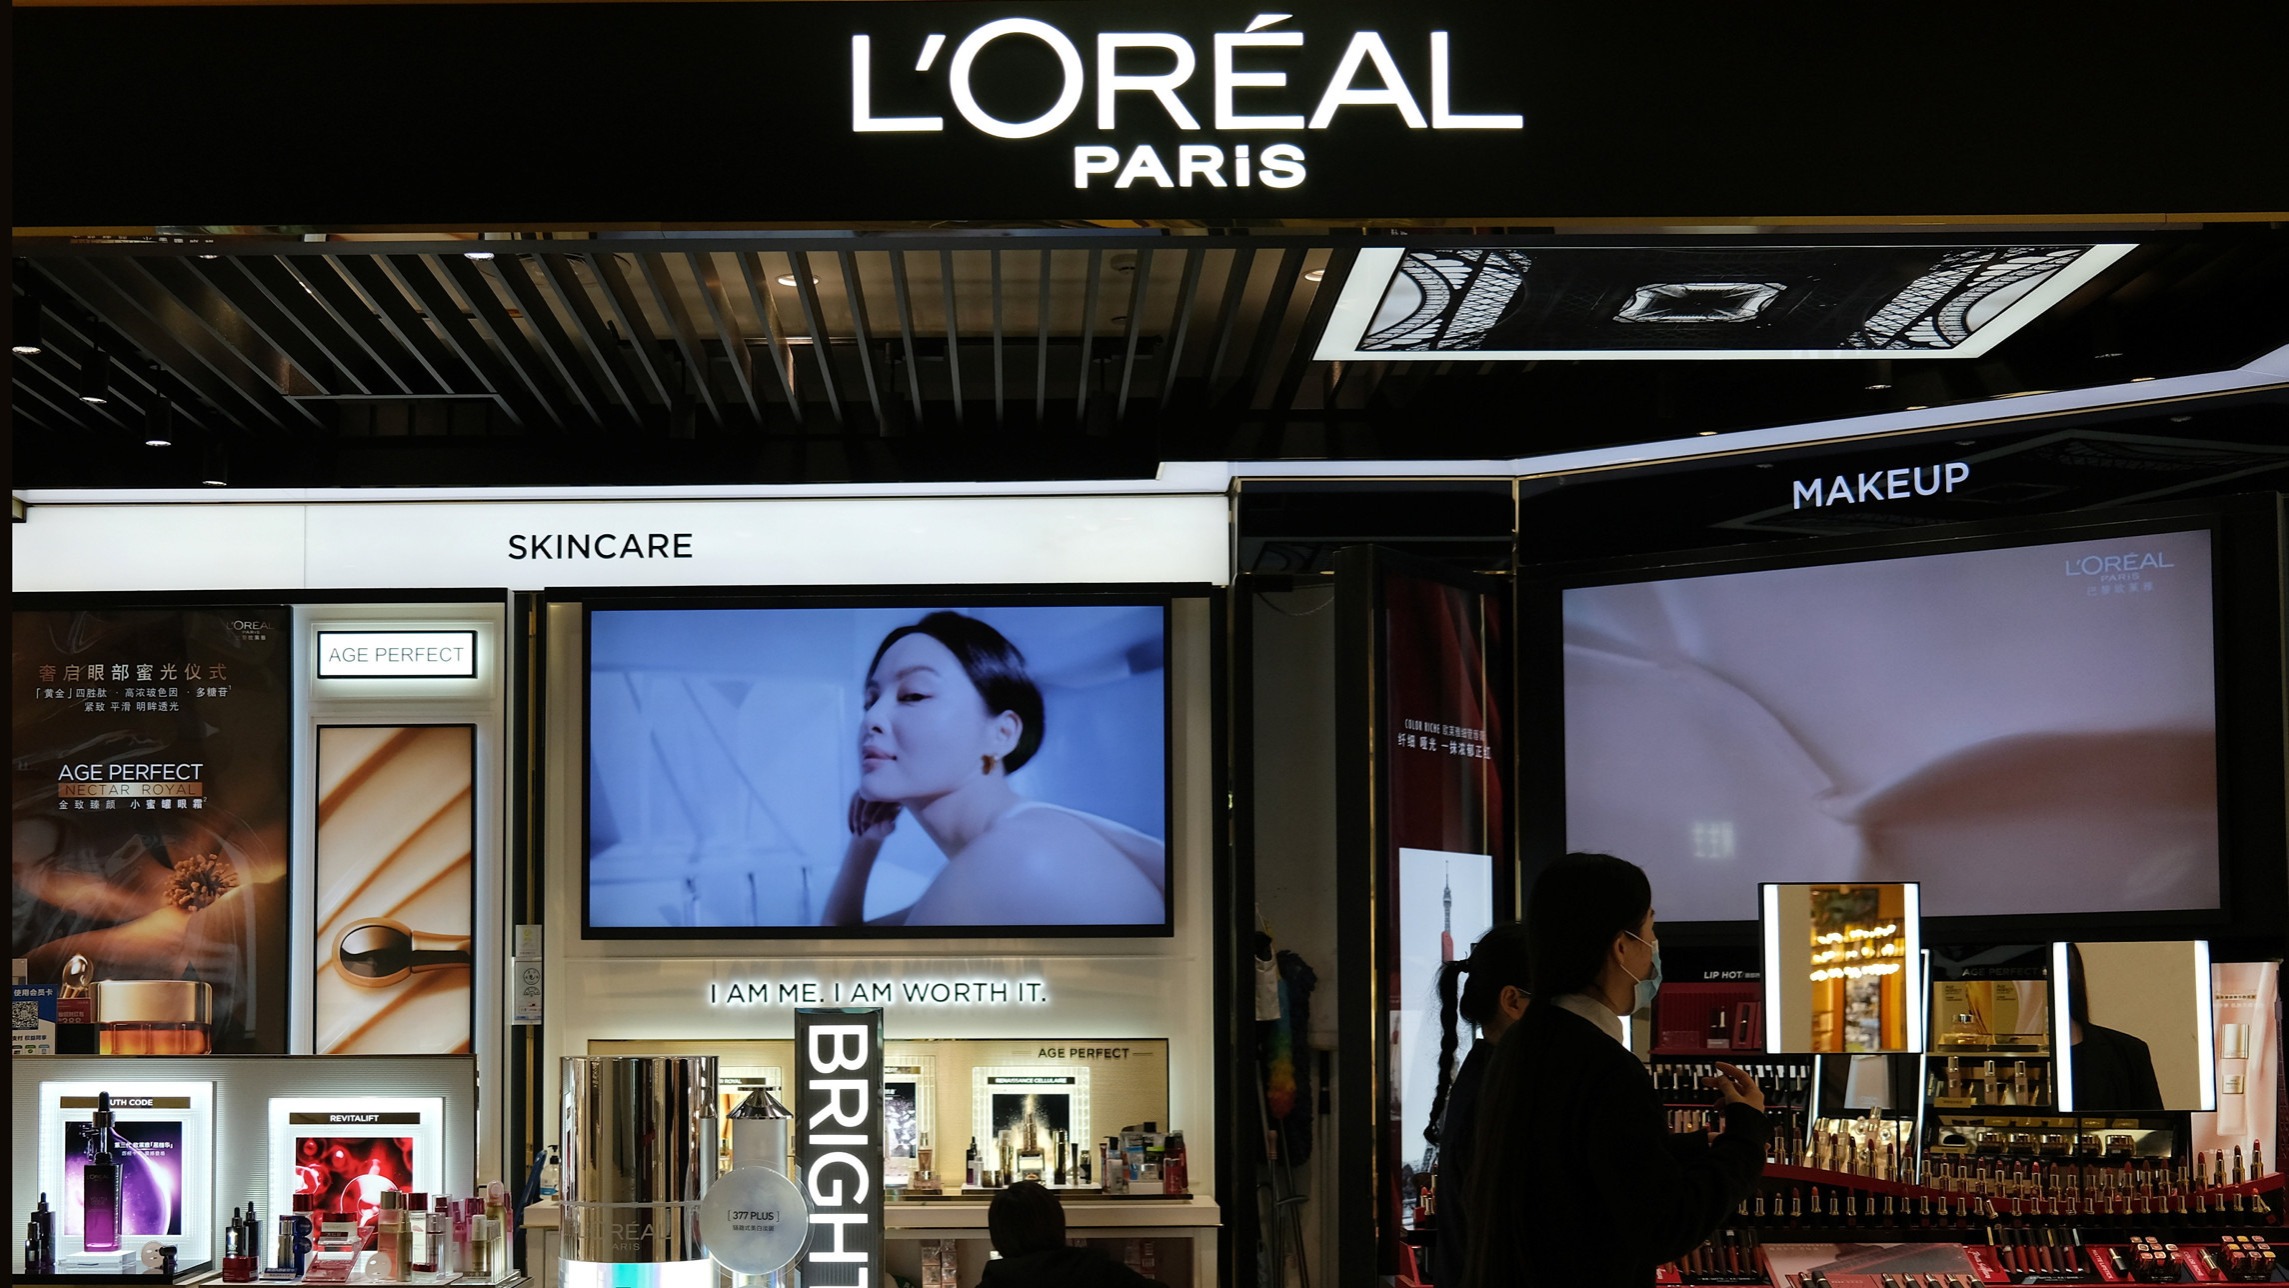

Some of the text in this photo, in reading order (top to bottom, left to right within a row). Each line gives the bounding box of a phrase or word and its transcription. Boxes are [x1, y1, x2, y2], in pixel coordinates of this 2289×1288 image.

[852, 14, 1523, 138] L'ORÉAL
[1793, 462, 1970, 509] MAKEUP
[508, 533, 692, 559] SKINCARE
[329, 647, 464, 662] AGE PERFECT
[39, 663, 227, 683] 奢启眼部蜜光仪式
[84, 702, 105, 712] 紧致
[110, 702, 131, 712] 平滑
[58, 763, 203, 781] AGE PERFECT
[65, 784, 196, 796] NECTAR ROYAL
[1703, 971, 1720, 980] LIP
[1721, 971, 1743, 980] HOT
[1962, 967, 1986, 977] AGE
[1989, 967, 2038, 977] PERFECT
[711, 982, 1046, 1003] I AM ME. I AM WORTH IT.
[1037, 1048, 1130, 1059] AGE PERFECT
[330, 1114, 379, 1122] REVITALIFT
